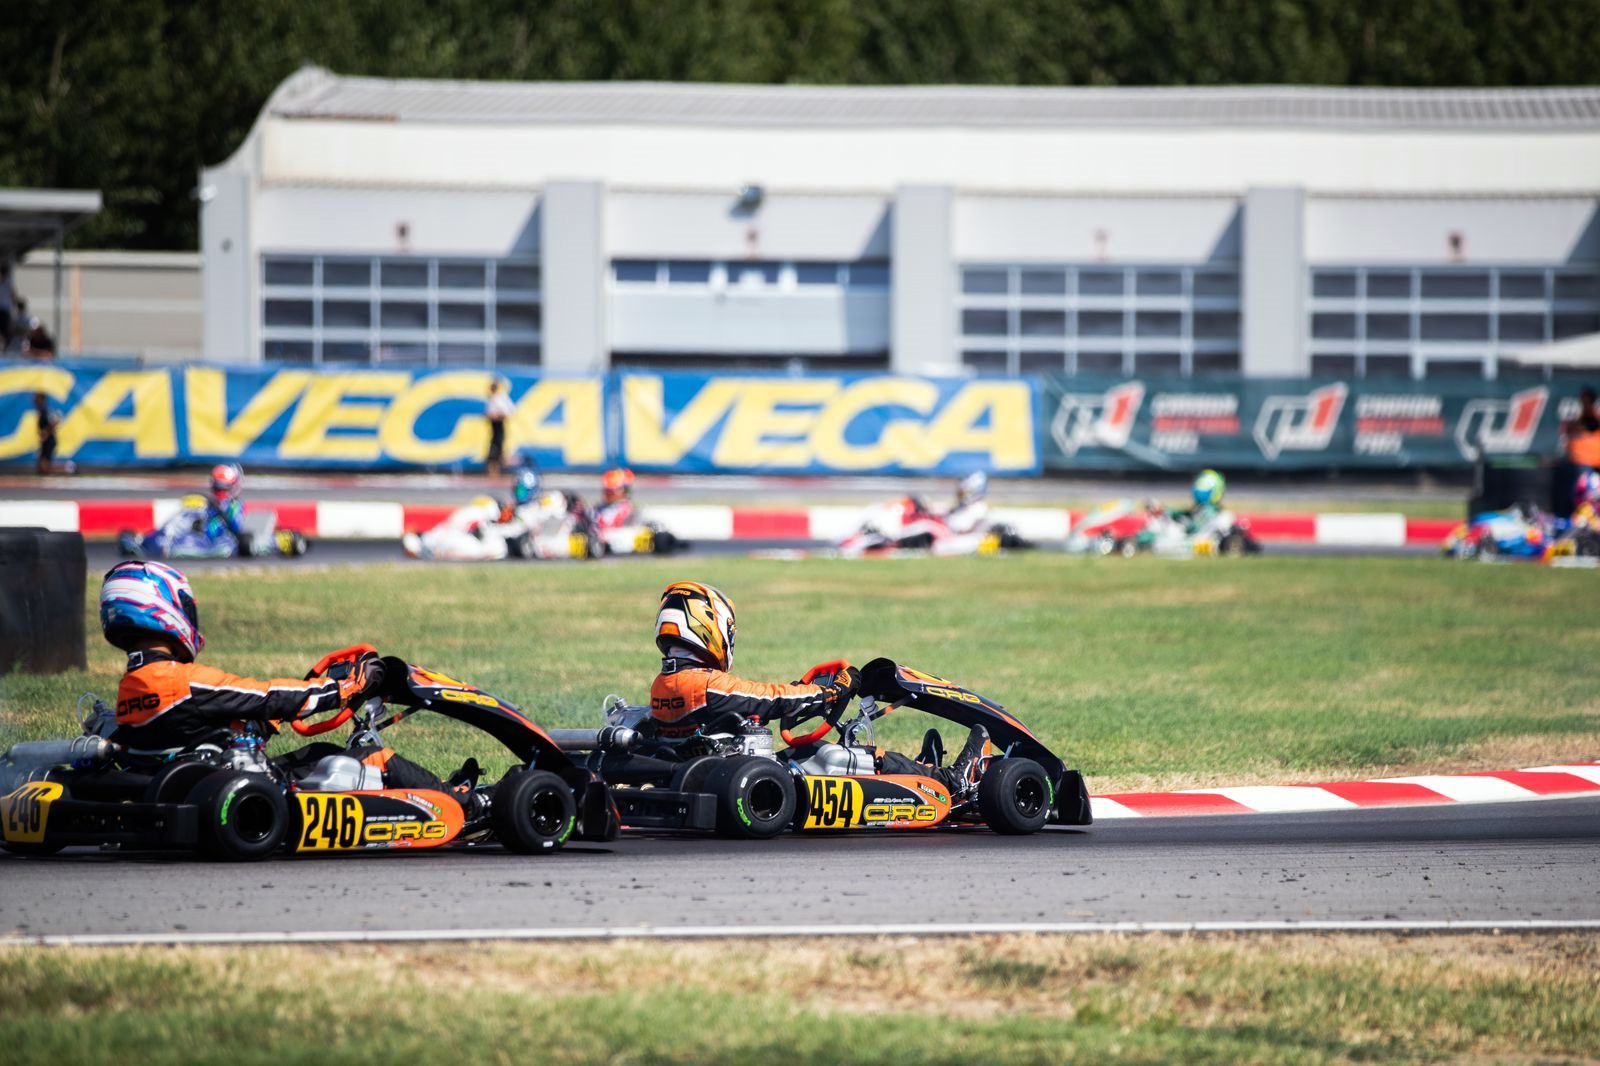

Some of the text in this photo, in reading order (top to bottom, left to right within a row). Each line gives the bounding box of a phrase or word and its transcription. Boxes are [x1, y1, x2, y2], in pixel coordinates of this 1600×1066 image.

[185, 367, 601, 466] VEGA
[621, 375, 1037, 471] VEGA
[440, 689, 499, 708] CRG
[925, 685, 981, 705] CRG
[8, 786, 52, 834] 246
[303, 796, 356, 849] 246
[810, 779, 854, 828] 454
[864, 803, 937, 823] CRG
[363, 820, 446, 842] CRG
